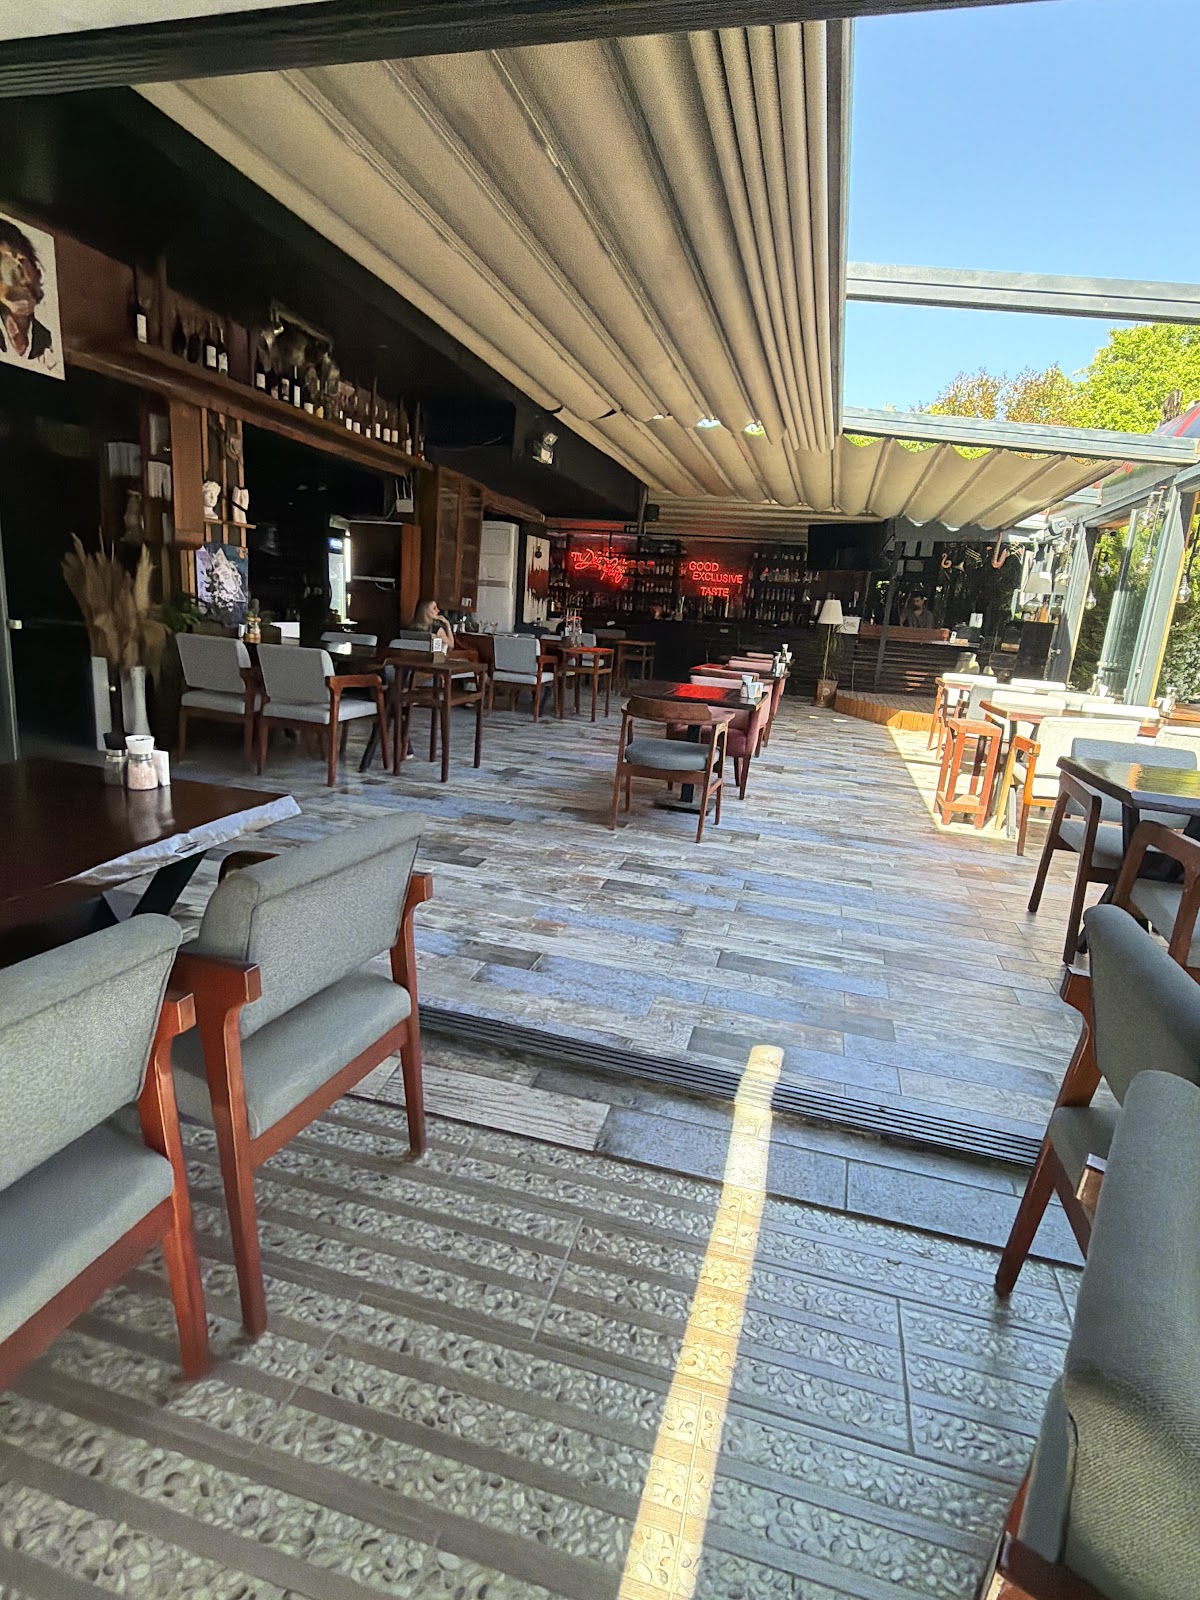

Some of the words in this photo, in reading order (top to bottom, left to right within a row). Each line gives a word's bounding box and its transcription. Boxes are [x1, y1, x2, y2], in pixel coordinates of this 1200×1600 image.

[689, 561, 719, 572] GOOD
[692, 571, 743, 584] EXCLUSIVE
[700, 587, 730, 597] TASTE
